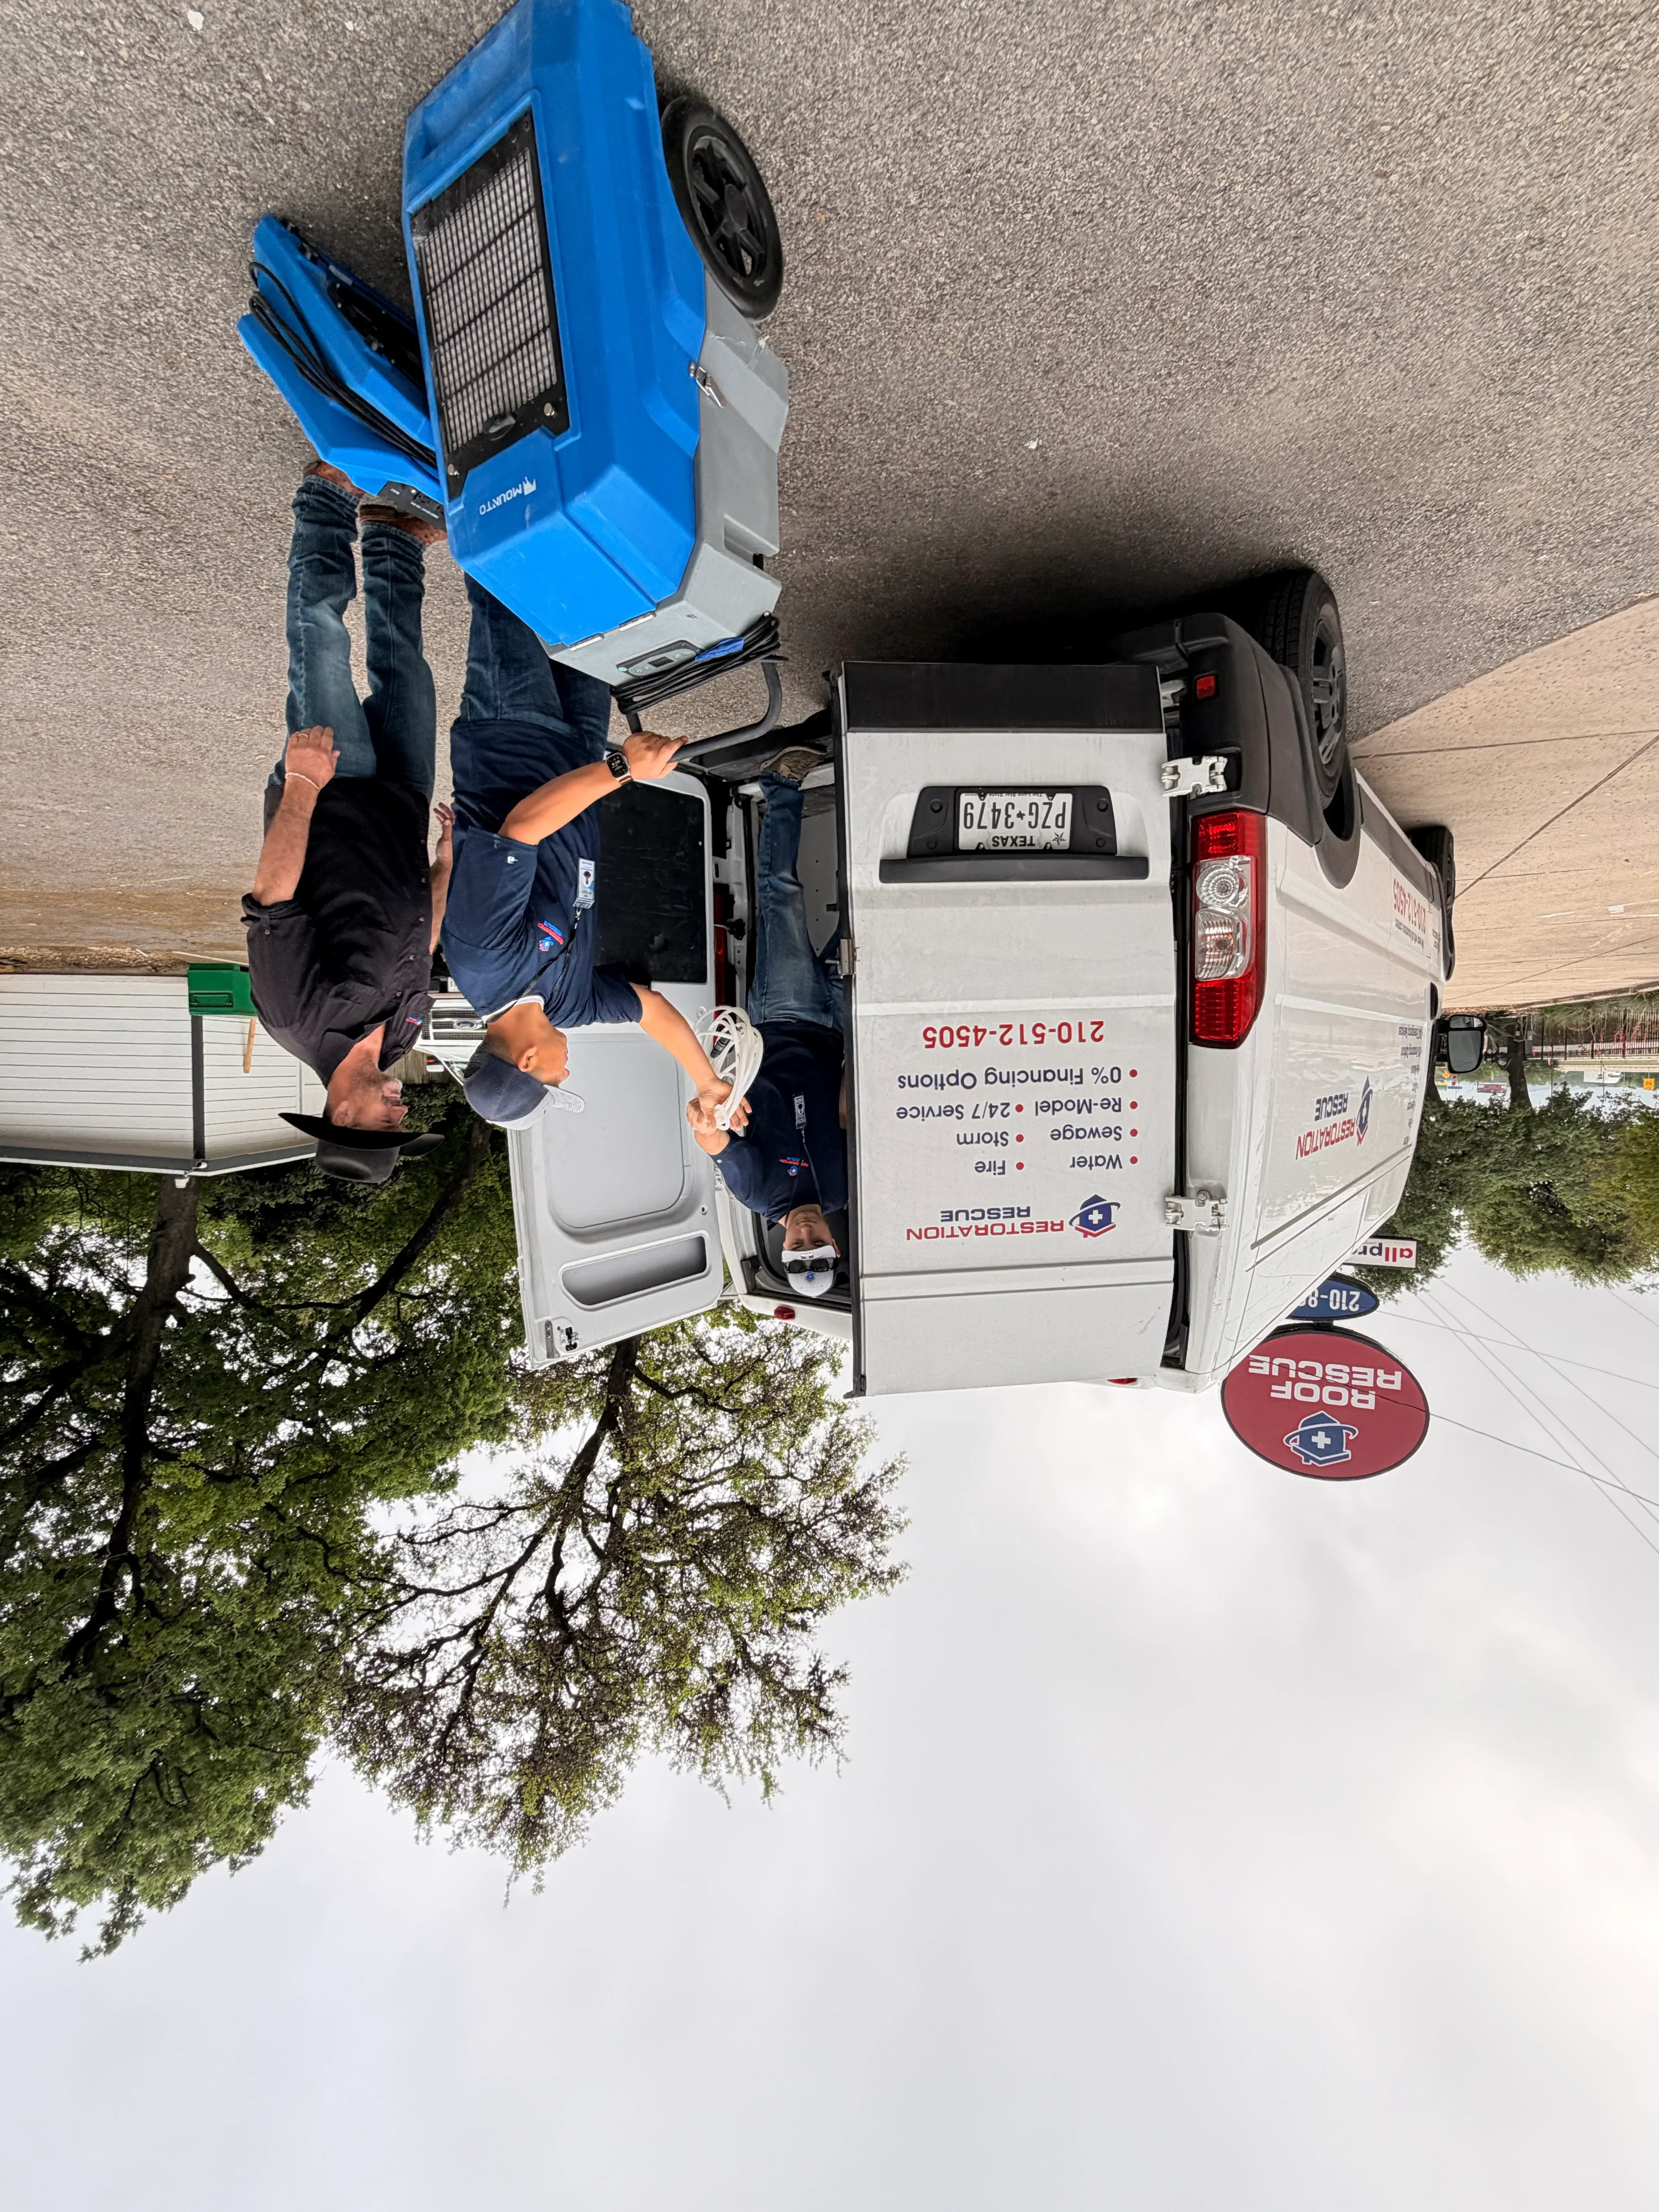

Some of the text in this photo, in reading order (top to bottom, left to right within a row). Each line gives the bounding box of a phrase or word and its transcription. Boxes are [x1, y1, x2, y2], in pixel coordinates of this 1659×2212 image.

[992, 836, 1035, 847] TEXAS
[1393, 878, 1425, 934] 210-512-4505
[922, 1021, 1104, 1048] 210-512-4505
[898, 1066, 1121, 1091] 0% Financing Options
[896, 1101, 1011, 1121] 24/7 Service
[1035, 1097, 1122, 1116] Re-Model
[1314, 1092, 1348, 1121] RESCUE
[956, 1131, 1009, 1147] Storm
[1050, 1124, 1122, 1142] Sewage
[1295, 1118, 1356, 1160] RESTORATION
[974, 1160, 1006, 1175] Fire
[1070, 1154, 1122, 1170] Water
[940, 1206, 1031, 1222] RESCUE
[906, 1220, 1064, 1241] RESTORATION
[1249, 1354, 1402, 1390] RESCUE
[1271, 1381, 1376, 1410] ROOF
